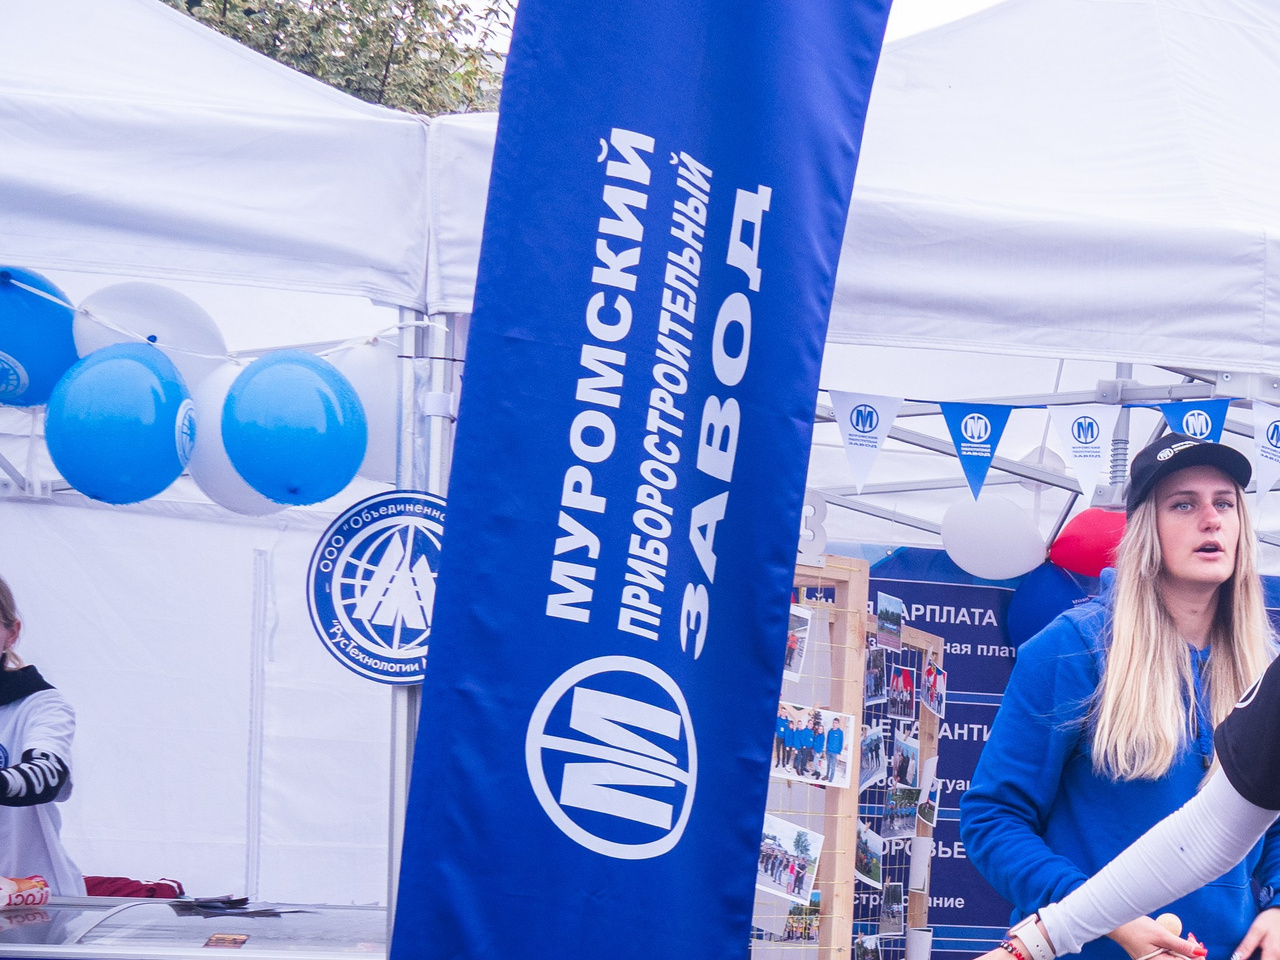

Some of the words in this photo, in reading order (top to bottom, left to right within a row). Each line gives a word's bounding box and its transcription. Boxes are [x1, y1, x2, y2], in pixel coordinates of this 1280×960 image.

[547, 128, 655, 622] МУРОМСКИЙ
[617, 151, 712, 639] ПРИБОРОСТРОИТЕЛЬНЫЙ
[679, 184, 772, 660] ЗАВОД
[901, 602, 998, 627] АРПЛАТА
